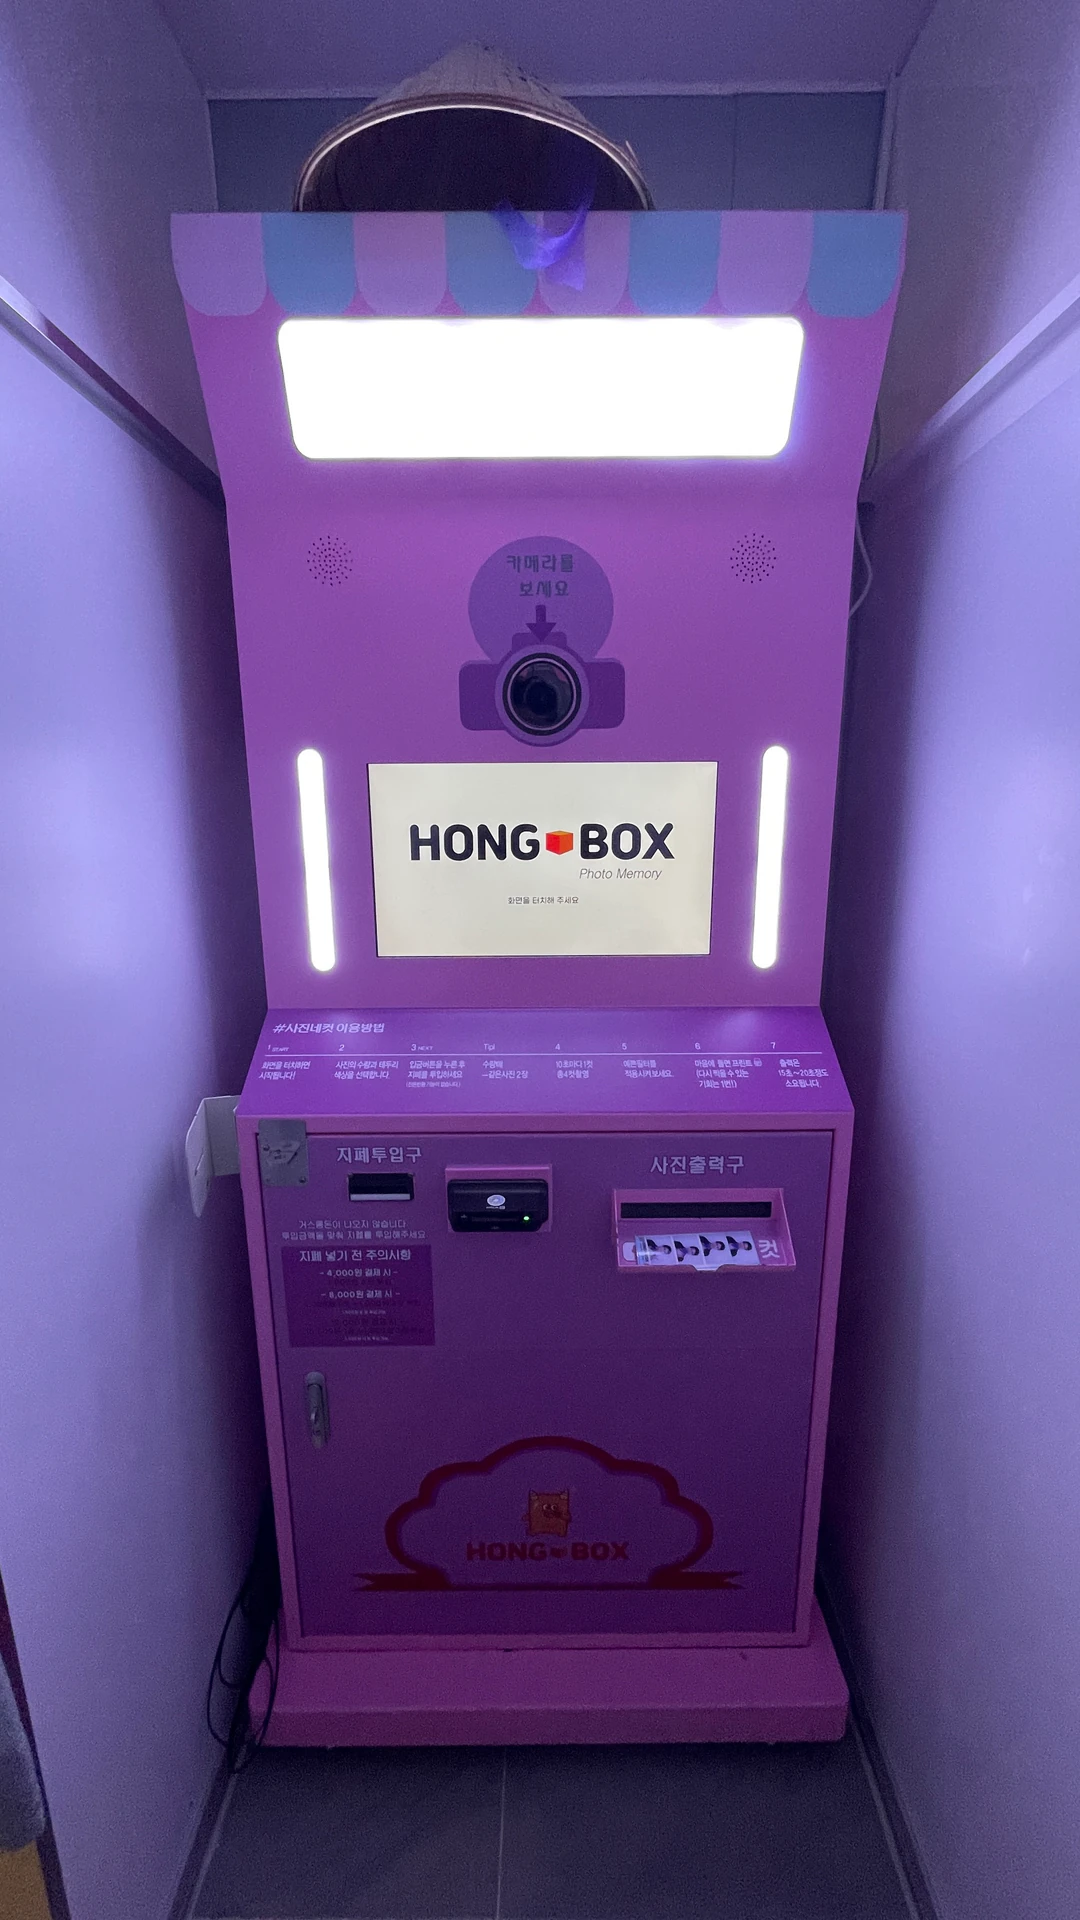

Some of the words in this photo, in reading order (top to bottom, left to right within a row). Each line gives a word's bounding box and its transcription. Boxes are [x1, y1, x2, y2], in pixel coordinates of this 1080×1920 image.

[506, 554, 574, 573] 카메라를
[519, 580, 569, 598] 보세요
[409, 823, 540, 861] HONG
[580, 822, 675, 860] BOX
[579, 868, 613, 880] Photo
[616, 868, 662, 881] Memory
[507, 896, 530, 905] 화면을
[532, 896, 555, 905] 터치해
[557, 896, 579, 905] 주세요
[273, 1023, 334, 1034] #사진네컷
[336, 1023, 385, 1034] 이용방법
[338, 1043, 345, 1052] 2
[410, 1043, 418, 1052] 3
[555, 1043, 561, 1051] 4
[622, 1042, 628, 1051] 5
[694, 1042, 702, 1050] 6
[770, 1041, 777, 1050] 7
[261, 1061, 283, 1070] 화면을
[283, 1061, 312, 1070] 터치하면
[335, 1060, 357, 1070] 사진의
[357, 1060, 378, 1069] 수량과
[378, 1060, 400, 1069] 테두리
[694, 1059, 716, 1068] 마음에
[732, 1059, 753, 1068] 프린트
[779, 1058, 801, 1068] 출력은
[334, 1070, 355, 1080] 색상을
[735, 1069, 749, 1078] 있는
[698, 1080, 720, 1089] 기회는
[336, 1146, 422, 1164] 지폐투입구
[650, 1155, 744, 1175] 사진출력구
[343, 1220, 369, 1229] 나오지
[299, 1250, 322, 1262] 지폐
[325, 1250, 348, 1262] 넣기
[351, 1249, 363, 1261] 전
[326, 1268, 363, 1278] 4,000원
[364, 1268, 382, 1277] 결제
[382, 1268, 392, 1277] 시
[328, 1290, 364, 1300] 8,000원
[365, 1290, 383, 1298] 결제
[383, 1289, 393, 1298] 시
[466, 1542, 548, 1561] HONG
[571, 1541, 629, 1560] BOX
